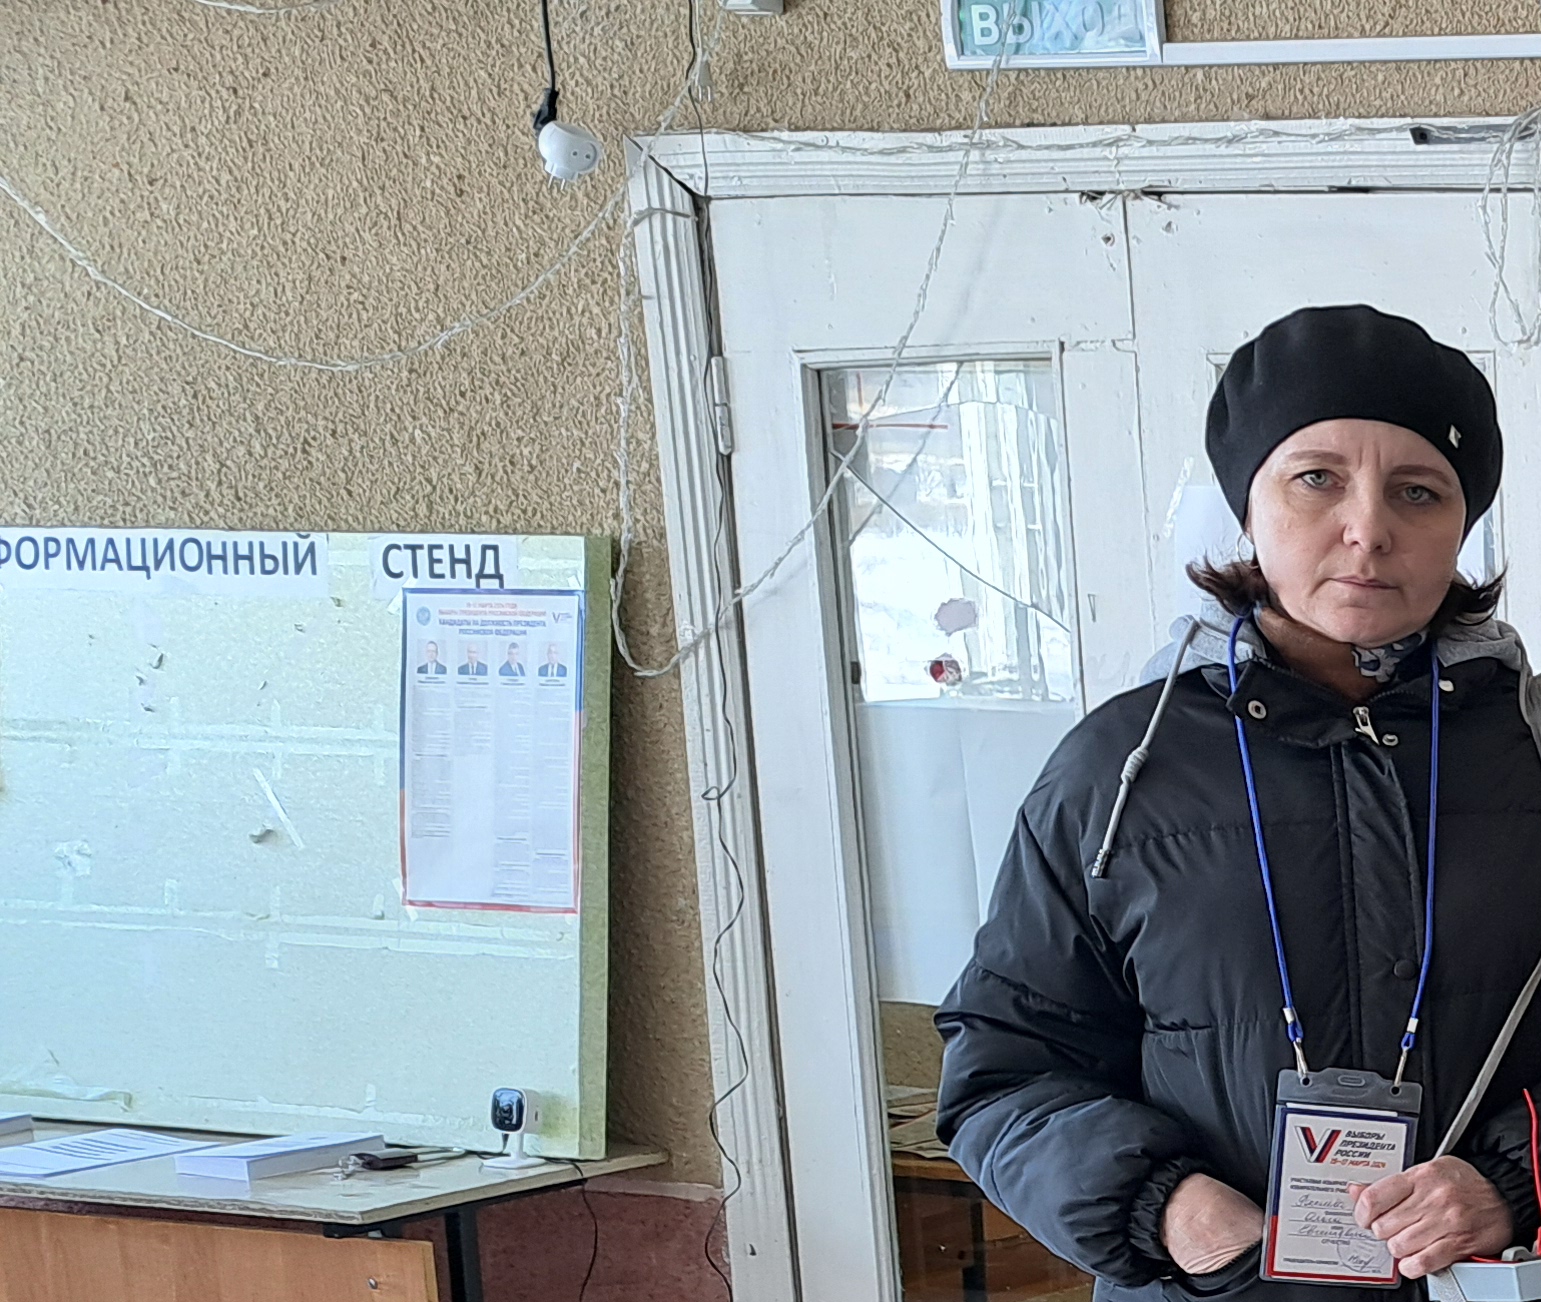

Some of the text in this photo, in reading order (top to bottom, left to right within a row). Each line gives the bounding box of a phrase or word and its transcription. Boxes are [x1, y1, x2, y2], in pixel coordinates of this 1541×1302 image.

[381, 543, 505, 590] СТЕНД
[1344, 1130, 1386, 1141] ВЫБОРЫ
[1339, 1139, 1396, 1151] ПРЕЗИДЕНТА
[1334, 1149, 1372, 1159] РОССИИ
